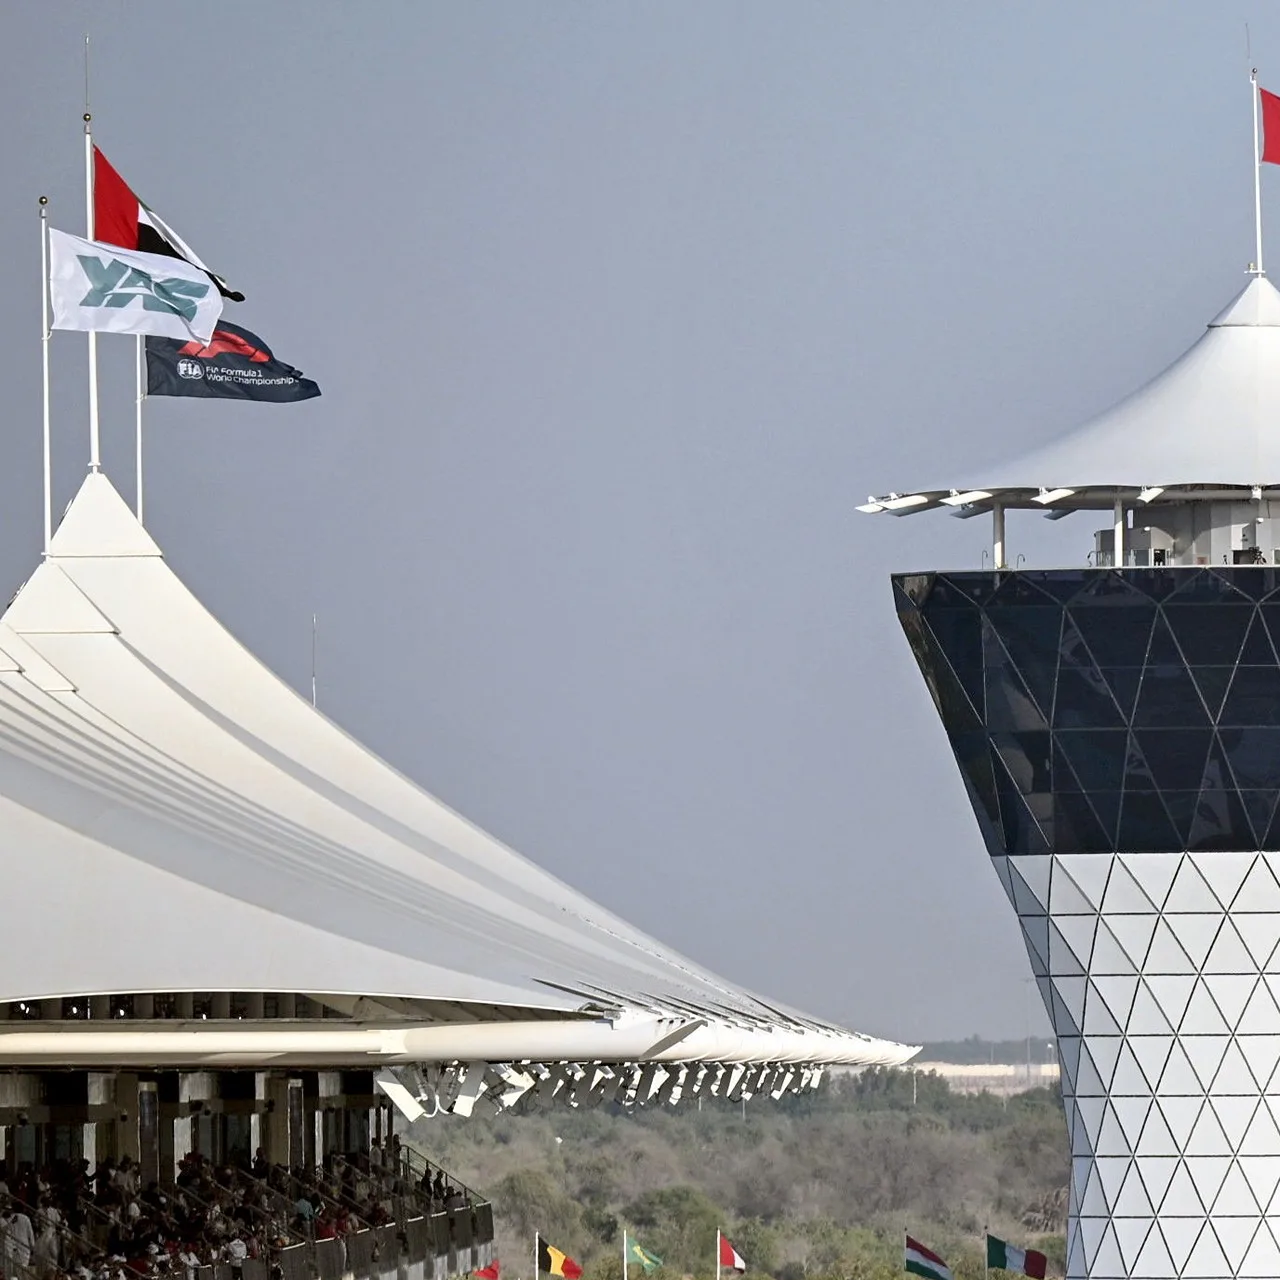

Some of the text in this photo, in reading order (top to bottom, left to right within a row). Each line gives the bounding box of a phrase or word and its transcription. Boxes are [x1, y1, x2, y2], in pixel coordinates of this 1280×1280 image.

[76, 254, 210, 323] YAS
[221, 367, 254, 378] Formula
[232, 375, 294, 387] Championship
